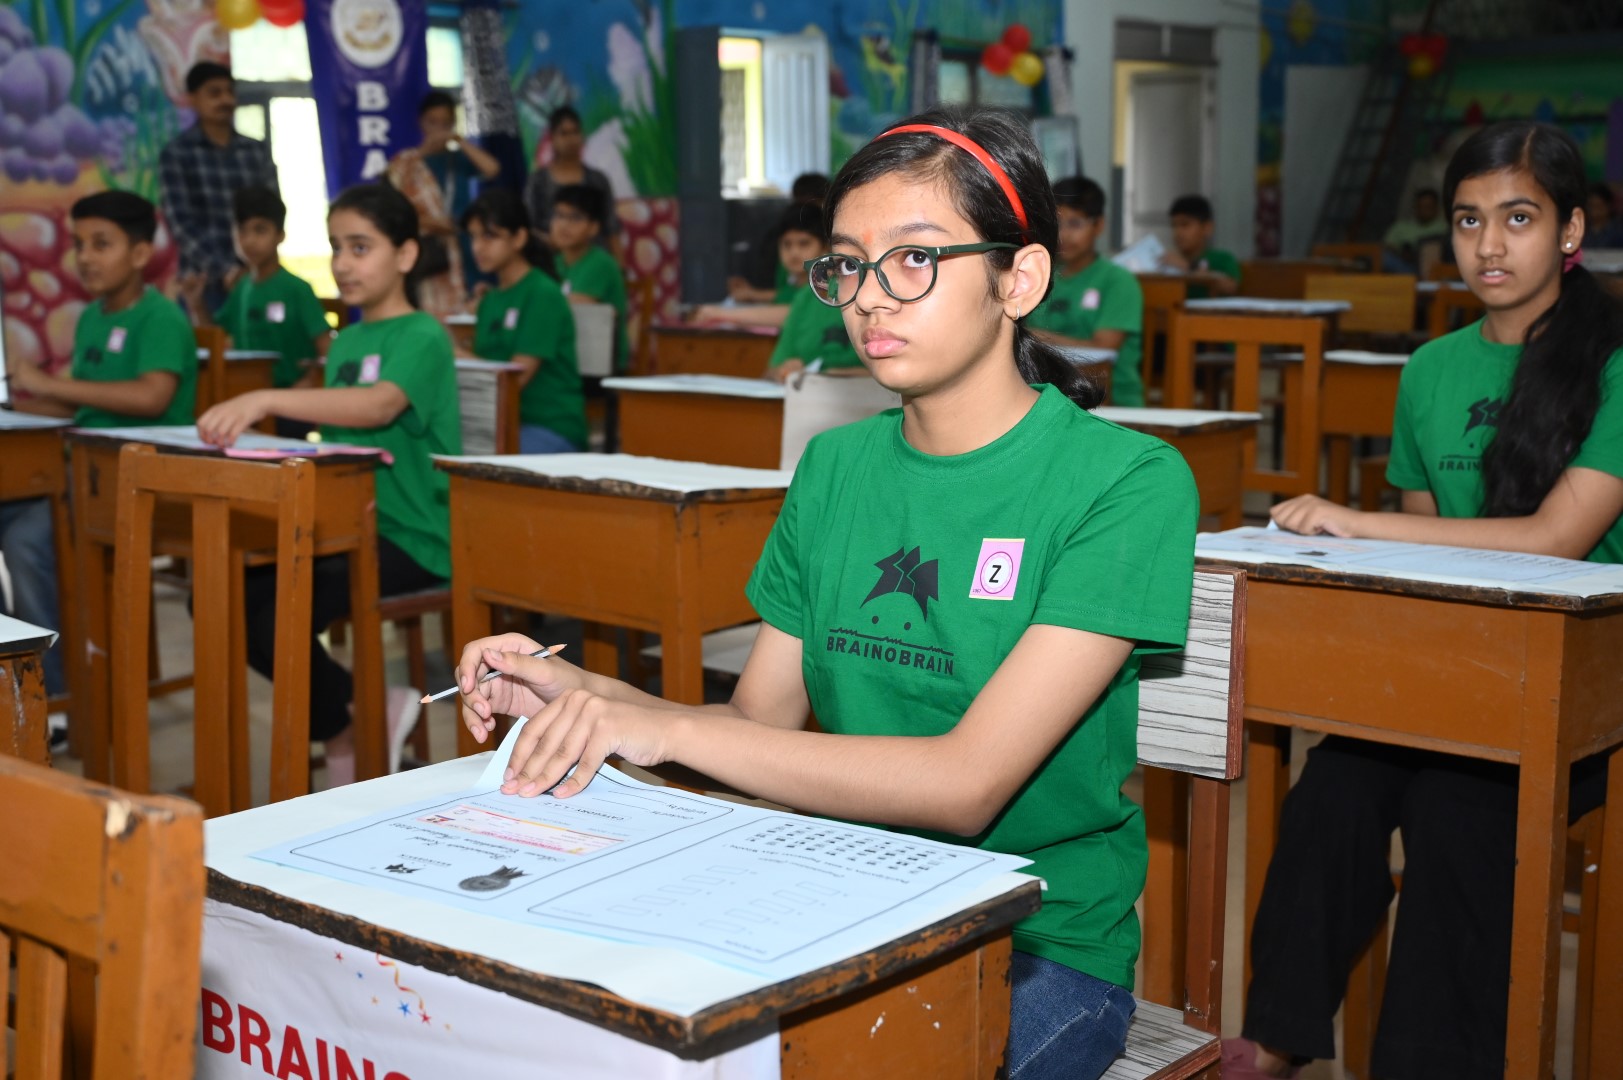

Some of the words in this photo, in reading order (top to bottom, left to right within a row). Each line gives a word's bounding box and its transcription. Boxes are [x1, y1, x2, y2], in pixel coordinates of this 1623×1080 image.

[988, 564, 1002, 584] Z
[826, 636, 954, 676] BRAINOBRAIN
[201, 987, 412, 1080] BRAIN
